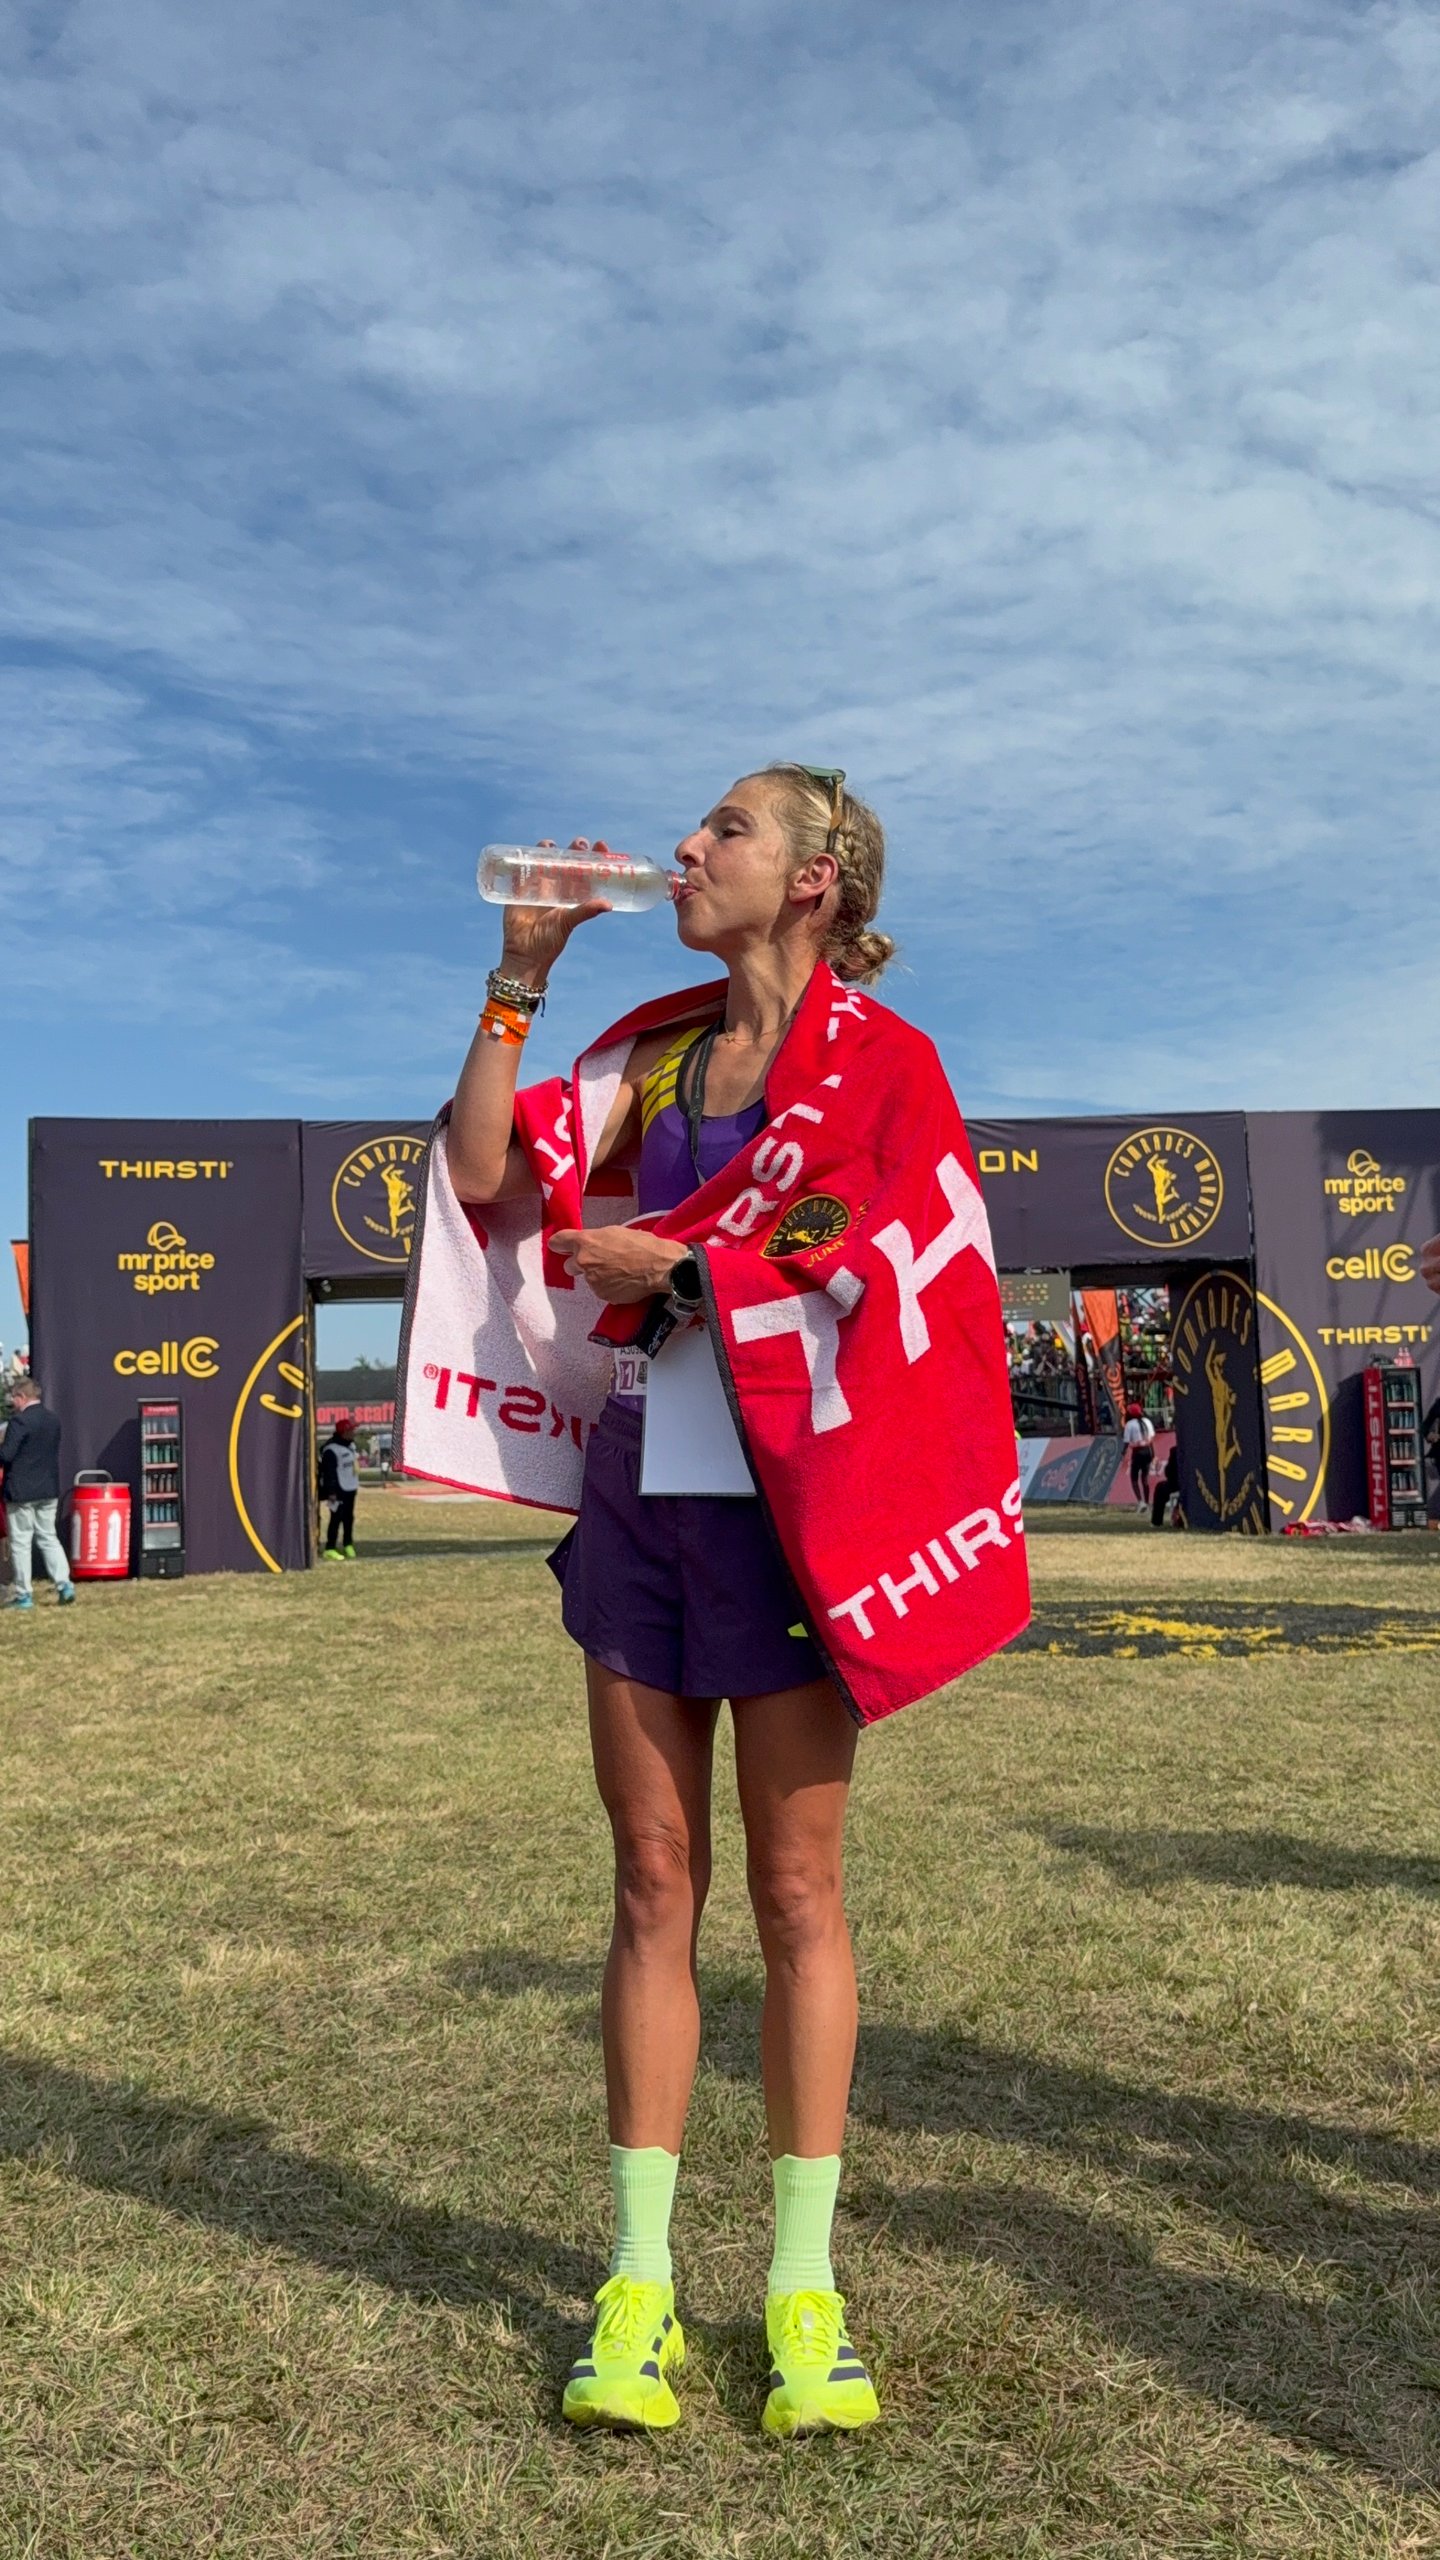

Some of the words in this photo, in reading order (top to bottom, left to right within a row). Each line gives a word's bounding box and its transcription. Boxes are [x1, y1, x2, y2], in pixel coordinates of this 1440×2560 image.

[343, 1143, 423, 1187] COMRADE
[1114, 1134, 1194, 1177] COMRADES
[1339, 1195, 1395, 1216] sport
[134, 1271, 200, 1295] sport
